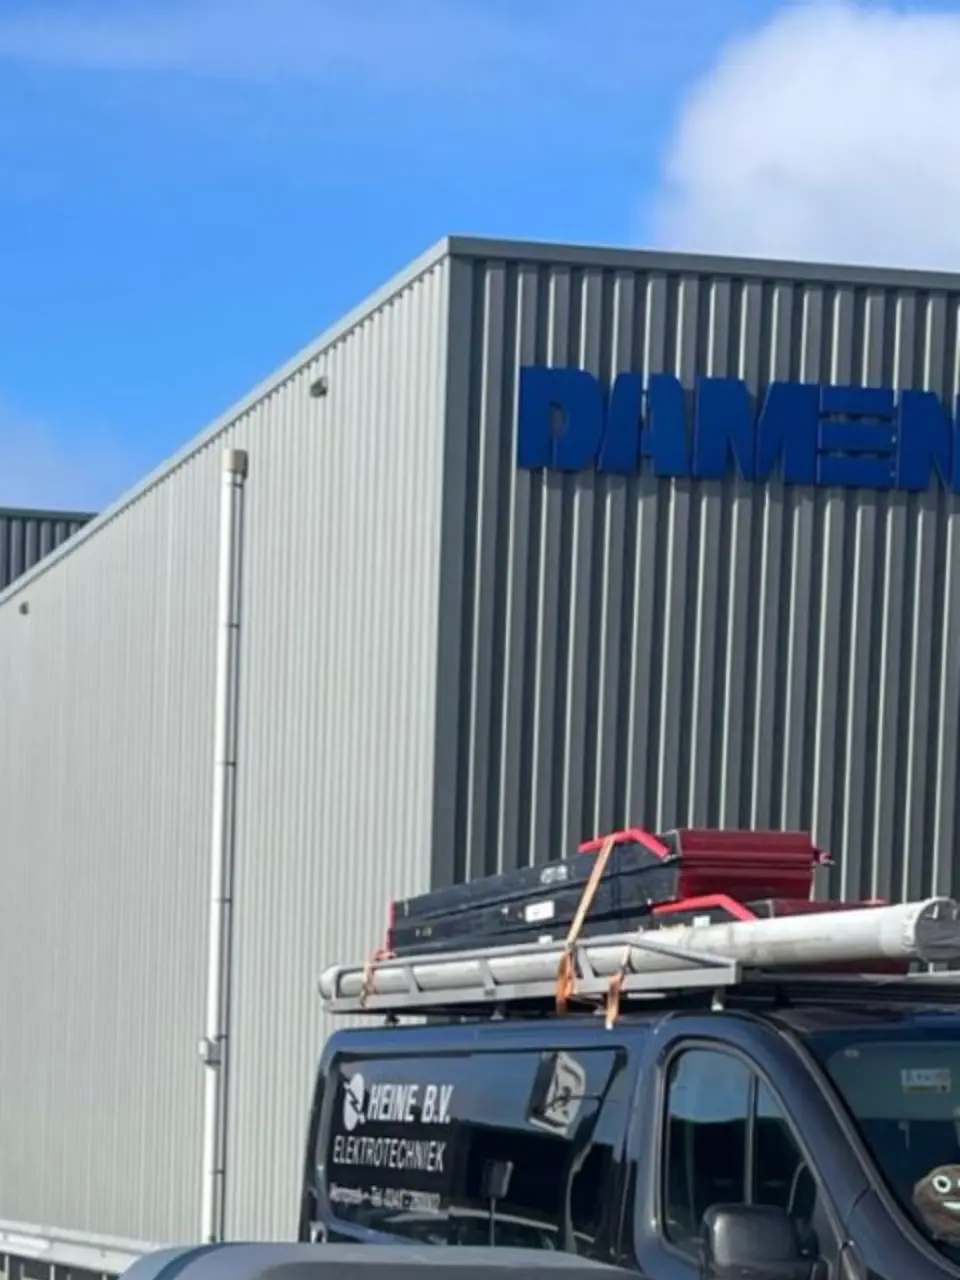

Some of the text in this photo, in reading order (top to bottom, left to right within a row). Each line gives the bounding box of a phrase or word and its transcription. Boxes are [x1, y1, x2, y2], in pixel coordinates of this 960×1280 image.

[517, 365, 960, 493] DAMEN
[367, 1083, 454, 1124] HEINE B.V.
[332, 1135, 446, 1173] ELEKTROTECHNIEK
